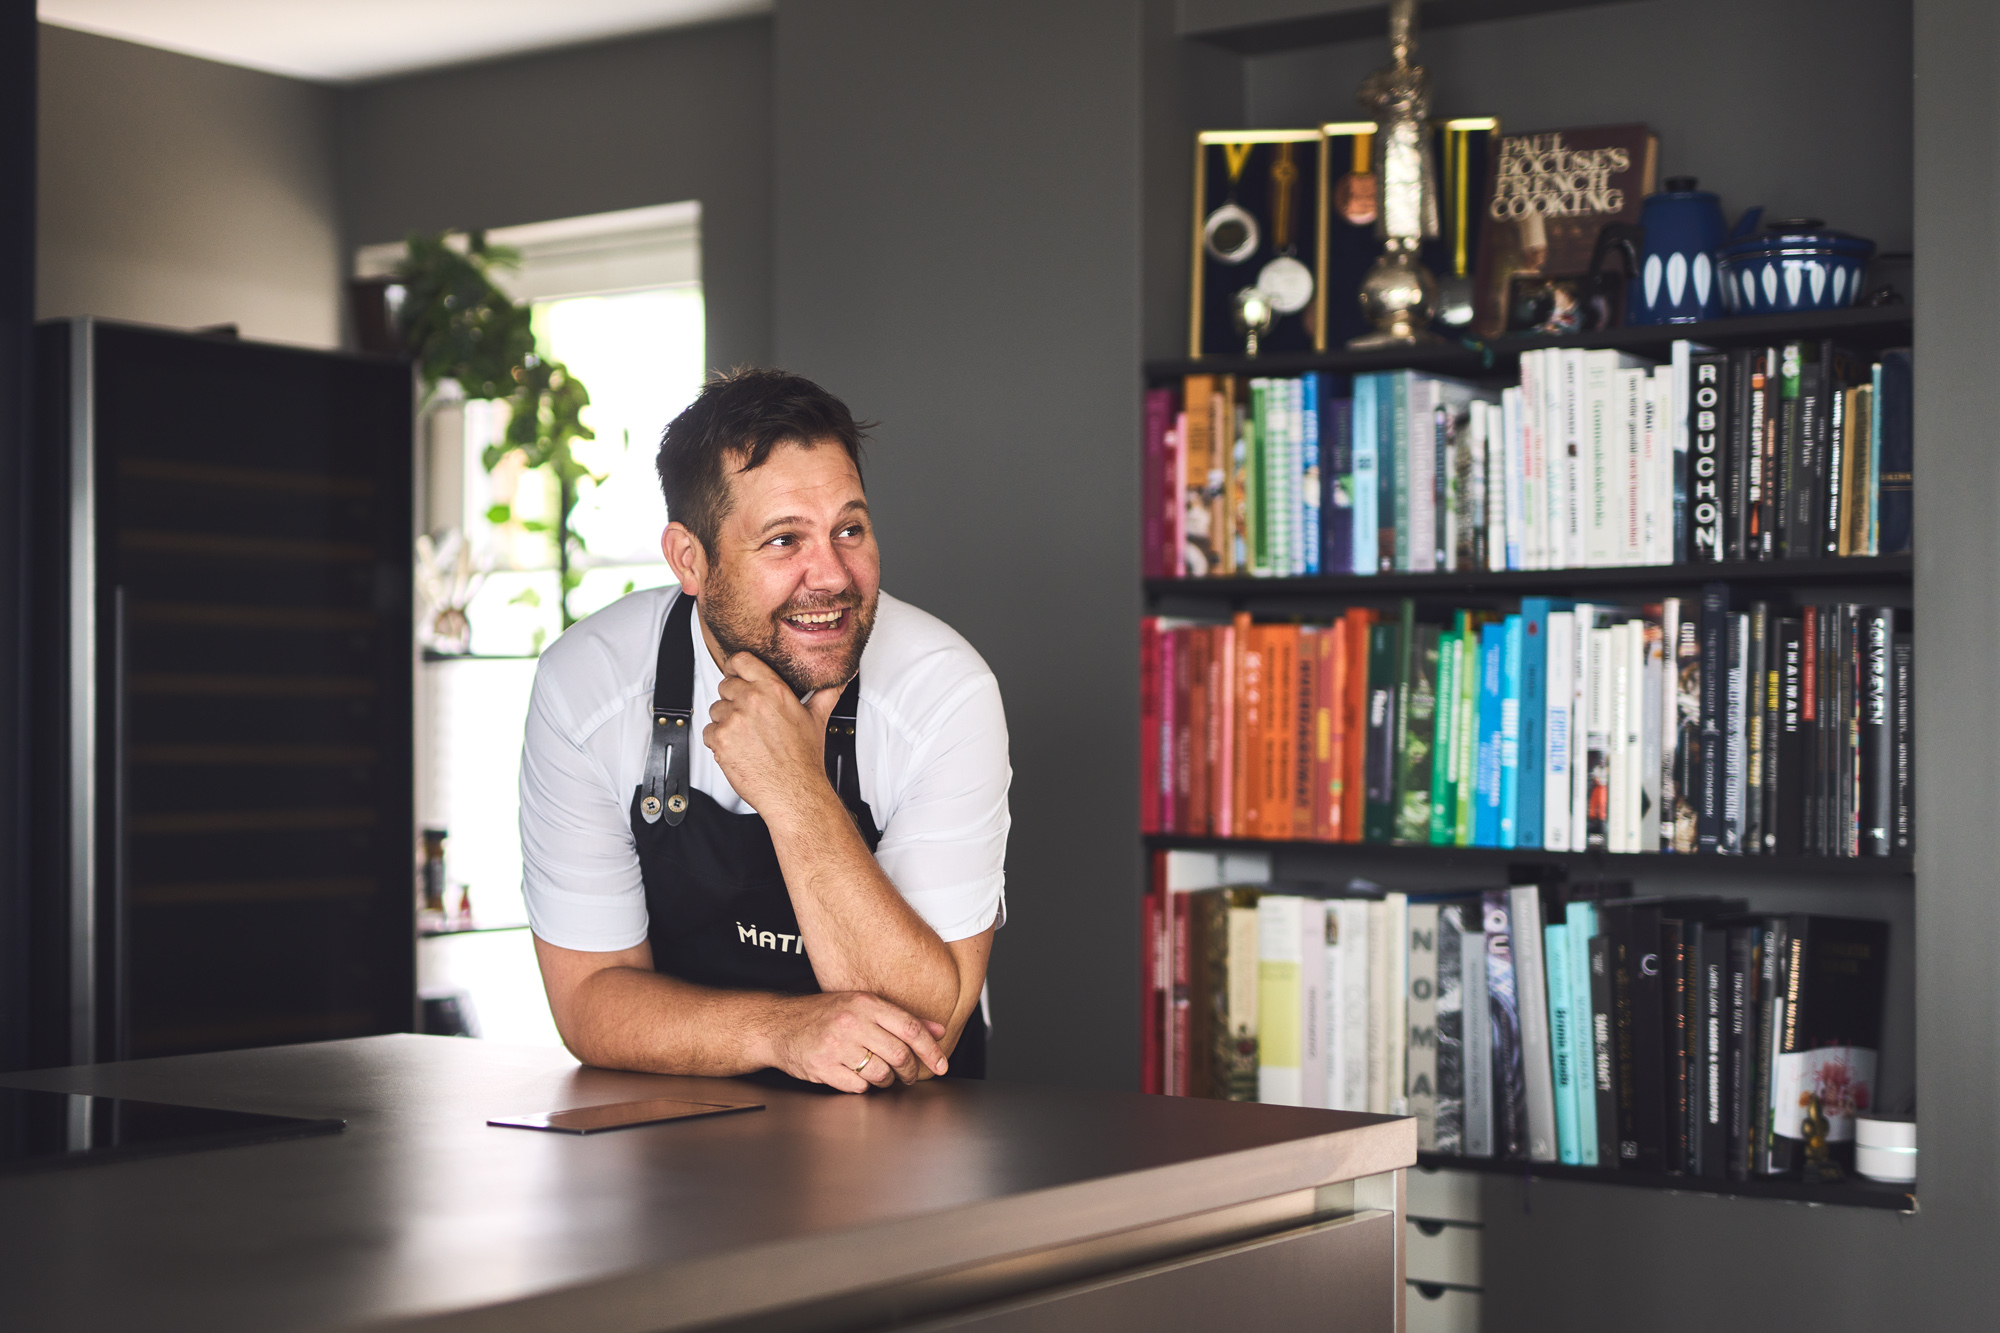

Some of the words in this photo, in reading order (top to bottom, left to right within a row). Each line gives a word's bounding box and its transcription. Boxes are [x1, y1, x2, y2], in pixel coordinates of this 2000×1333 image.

[1493, 169, 1610, 196] FRENCH
[1497, 147, 1630, 176] BOCUSE'S
[1499, 132, 1569, 156] PAUL
[1490, 188, 1623, 222] COOKING
[1694, 363, 1718, 547] ROBUCHON
[1785, 640, 1799, 733] THAIMANI
[1868, 618, 1885, 725] SØLVRÆVEN
[1488, 909, 1511, 997] QUAY
[1412, 929, 1433, 1097] NOMA
